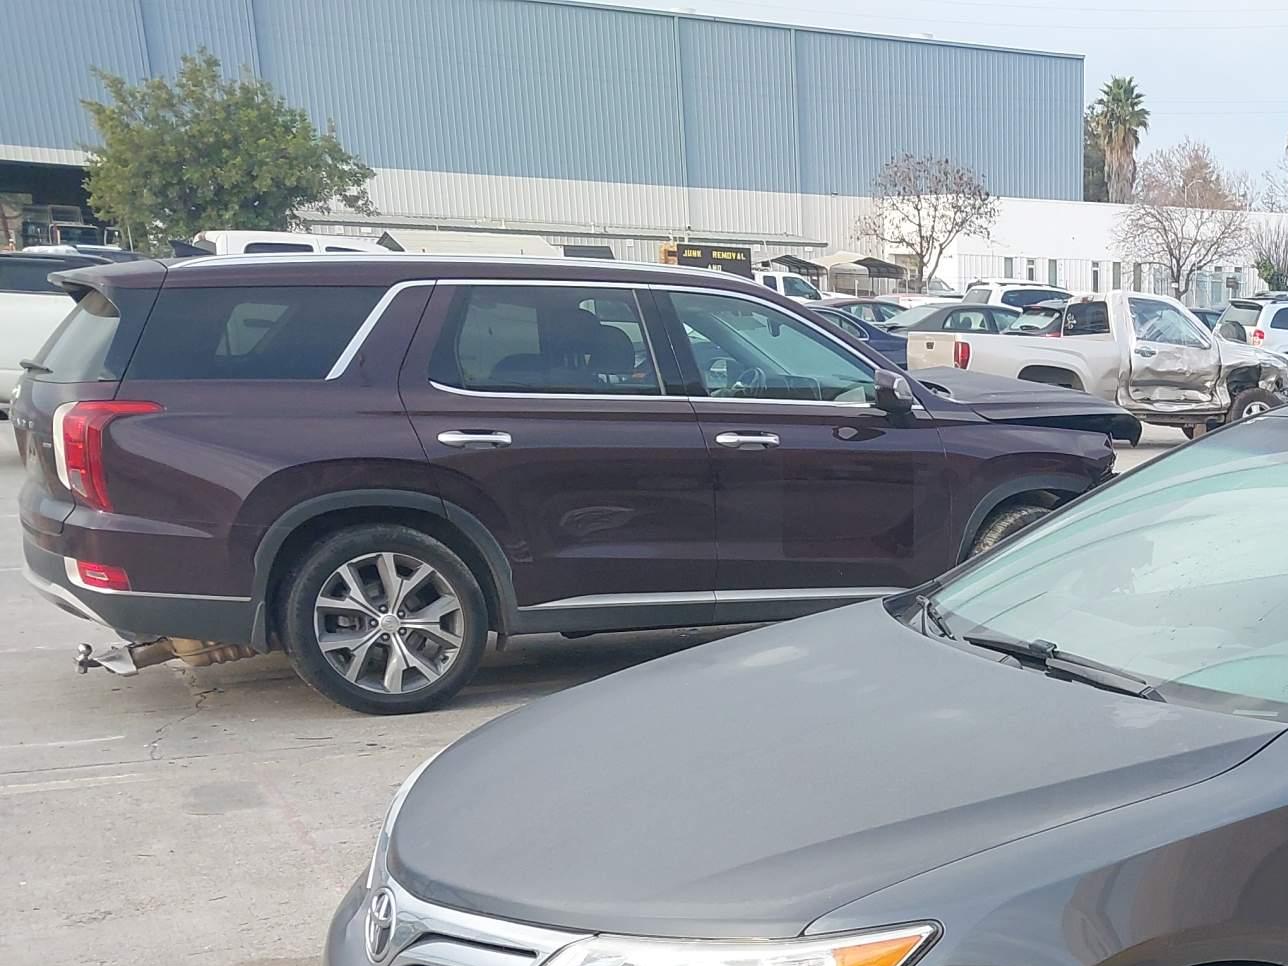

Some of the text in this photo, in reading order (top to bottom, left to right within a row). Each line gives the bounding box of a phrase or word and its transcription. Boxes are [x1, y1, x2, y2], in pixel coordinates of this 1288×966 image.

[682, 249, 746, 260] JUNK REMOVAL
[707, 263, 722, 272] AND
